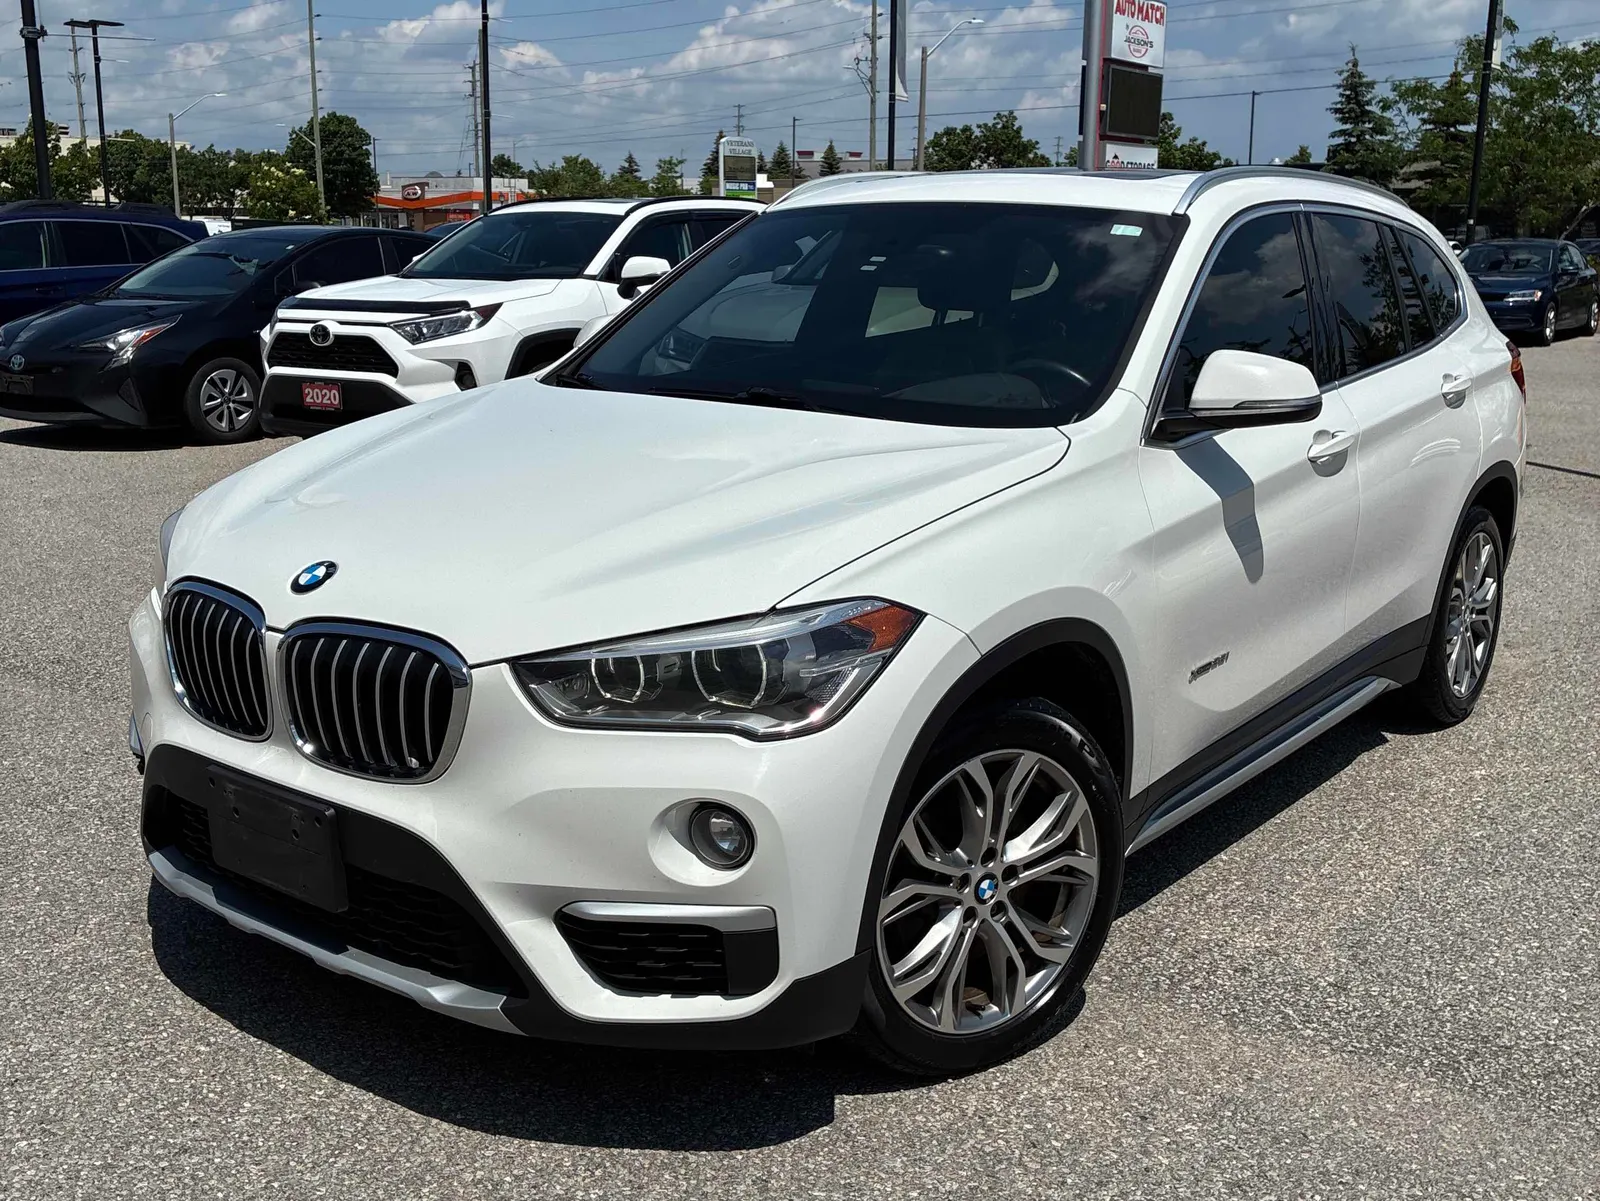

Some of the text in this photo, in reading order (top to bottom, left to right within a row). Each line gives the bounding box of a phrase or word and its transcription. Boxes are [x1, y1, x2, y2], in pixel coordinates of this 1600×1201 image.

[1115, 0, 1165, 26] AUTO MATCH
[1124, 36, 1154, 48] JACKSON'S
[305, 388, 340, 404] 2020
